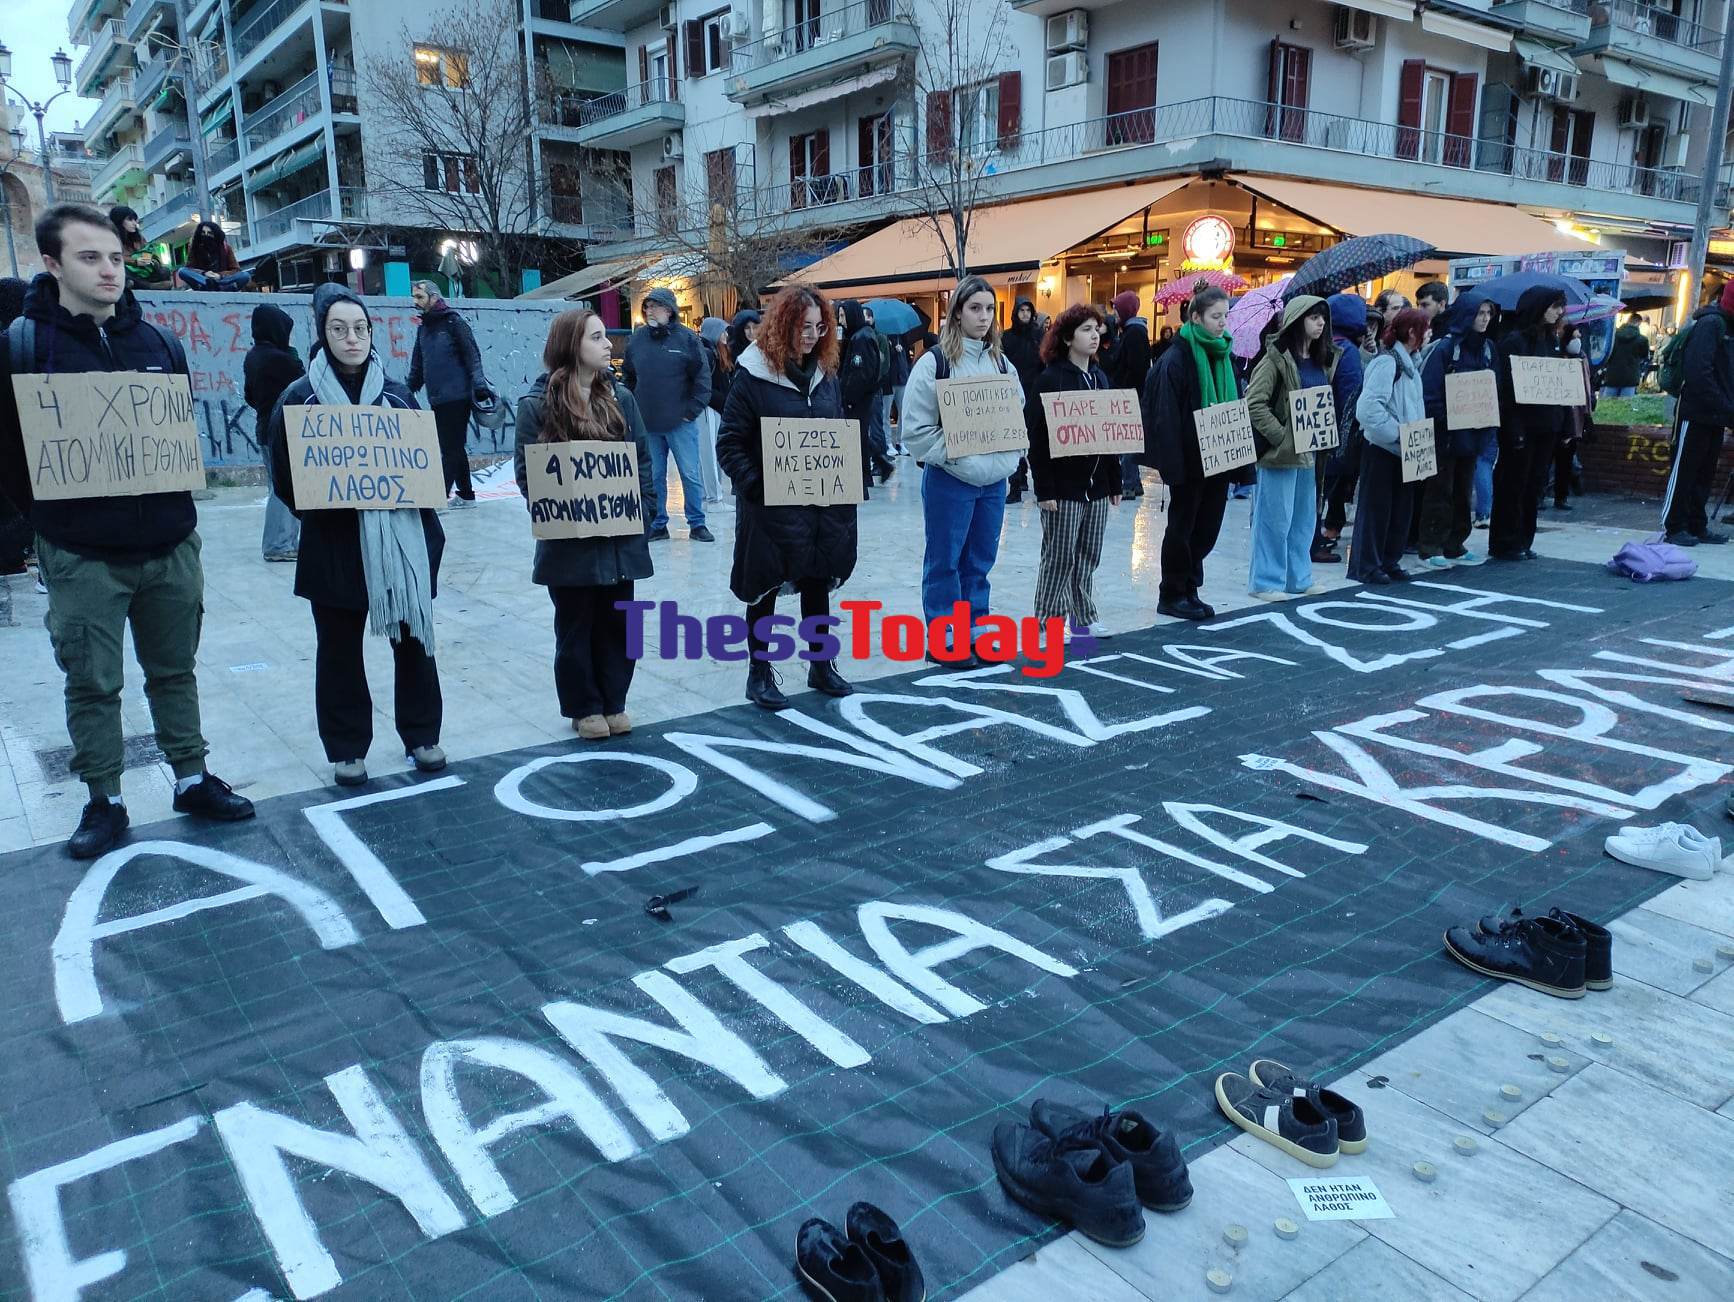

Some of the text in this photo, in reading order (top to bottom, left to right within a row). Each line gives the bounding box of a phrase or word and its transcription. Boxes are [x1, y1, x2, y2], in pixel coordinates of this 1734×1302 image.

[37, 384, 195, 430] 4 ΧΡΟΝΙΑ
[1052, 399, 1132, 417] ΠΑΡΕ ΜΕ
[1295, 397, 1307, 411] ΟΙ
[302, 412, 402, 440] ΔΕΝ ΗΤΑΝ
[1210, 405, 1246, 429] ΑΝΟΙΞΗ
[1295, 411, 1322, 432] ΜΑΣ
[774, 430, 841, 451] ΟΙ ΖΩΕΣ
[1056, 421, 1143, 445] ΟΤΑΝ ΦΤΑΣΕΙΣ
[1199, 425, 1253, 452] ΣΤΑΜΑΤΗΣΕ
[36, 431, 200, 487] ΑΤΟΜΙΚΗ ΕΥΘΥΝΗ
[303, 445, 430, 470] ΑΝΘΡΩΠΙΝΟ
[545, 453, 563, 486] 4
[569, 451, 634, 481] ΧΡΟΝΙΑ
[774, 454, 844, 473] ΜΑΣ ΕΧΟΥΝ
[1203, 444, 1253, 471] ΣΤΑ ΤΕΜΠΗ
[328, 474, 416, 504] ΛΑΘΟΣ
[787, 475, 844, 497] ΑΞΙΑ
[531, 488, 642, 525] ΑΤΟΜΙΚΗ ΕΥΘΥΝΗ
[51, 663, 1213, 1025] ΑΓΩΝΑΣ
[1197, 579, 1605, 674] ΖΩΗ
[7, 900, 1079, 1302] ΕΝΑΝΤΙΑ
[984, 800, 1370, 939] ΣΤΑ
[1303, 1183, 1362, 1194] ΔΕΝ ΗΤΑΝ
[1308, 1192, 1377, 1203] ΑΝΘΡΩΠΙΝΟ
[1313, 1202, 1354, 1212] ΛΑΘΟΣ
